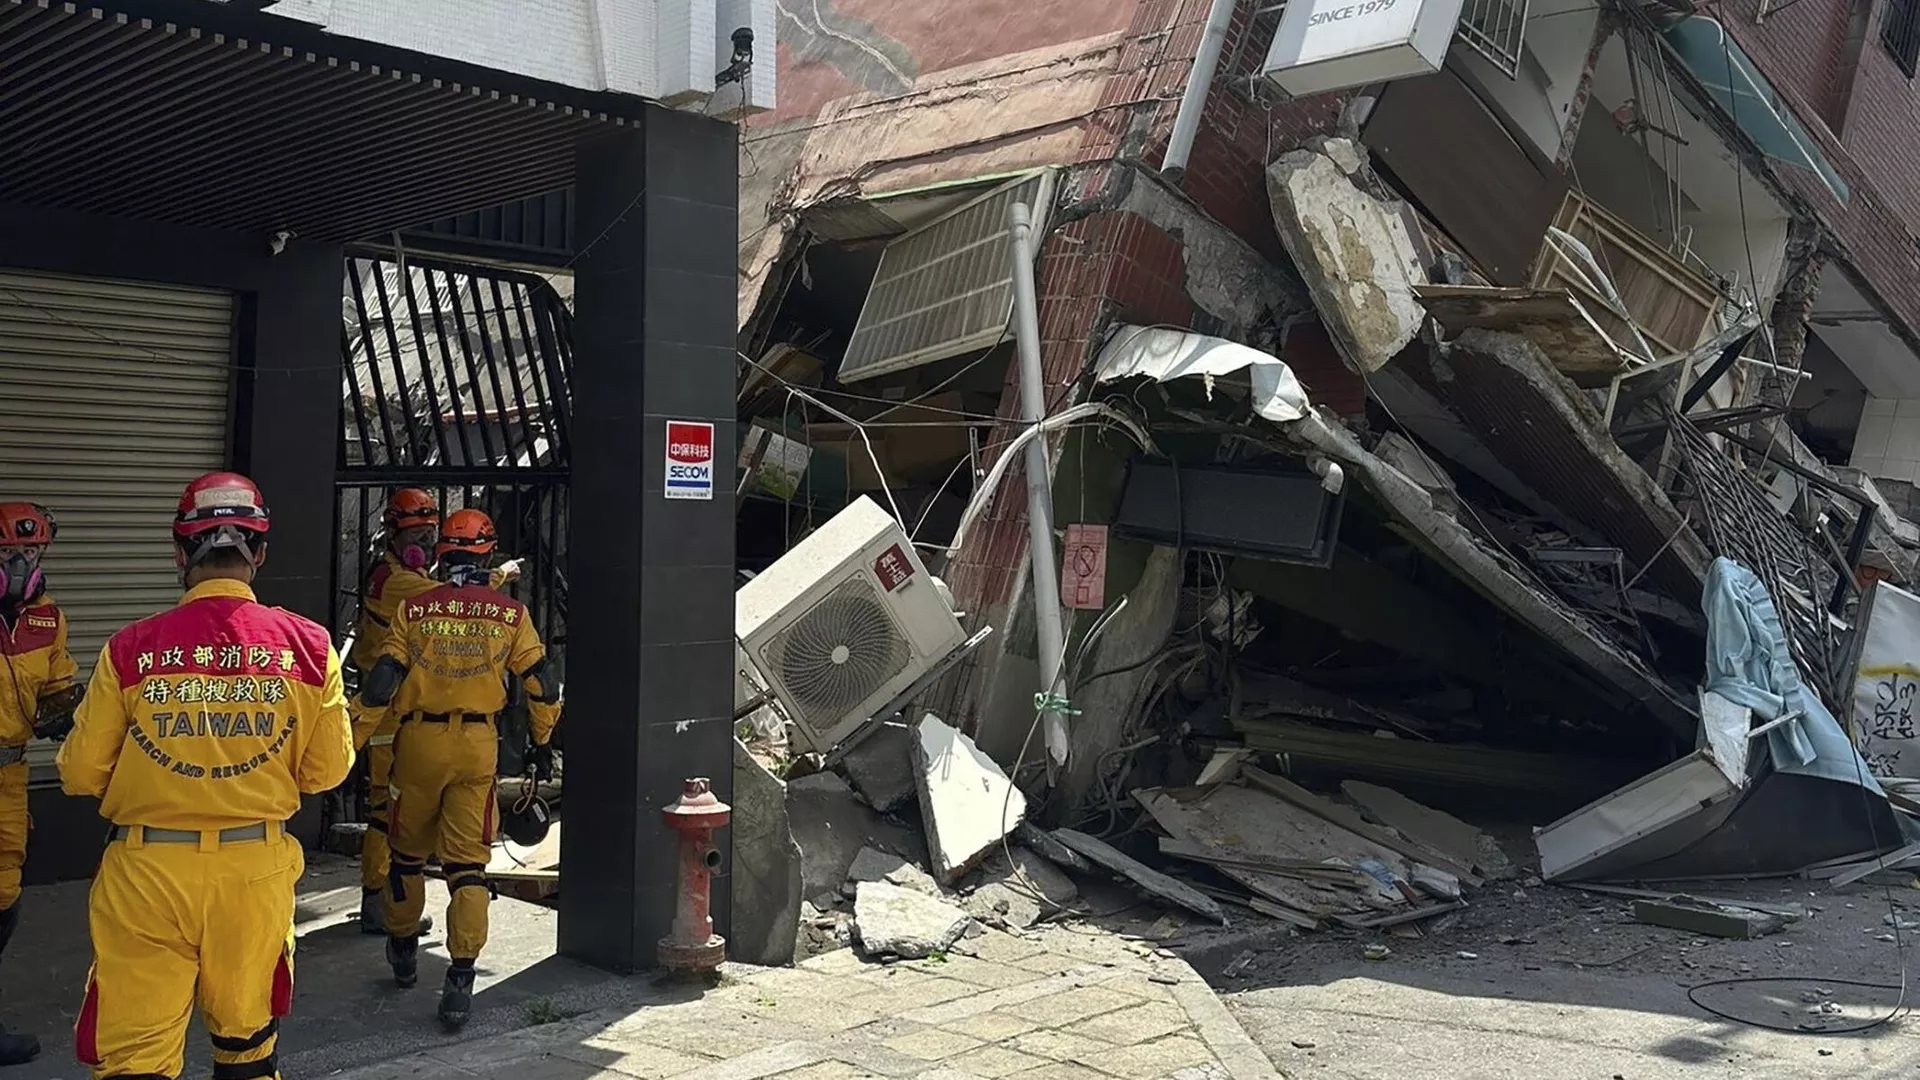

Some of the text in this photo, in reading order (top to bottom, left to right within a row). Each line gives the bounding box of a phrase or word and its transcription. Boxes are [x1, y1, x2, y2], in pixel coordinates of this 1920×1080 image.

[1308, 0, 1395, 27] SINCE 1979
[670, 442, 710, 458] 中保科技
[670, 465, 709, 479] SECOM
[143, 677, 287, 703] 特種搜救隊
[153, 711, 276, 737] TAIWAN
[171, 761, 205, 778] AND
[211, 752, 270, 779] RESCUE
